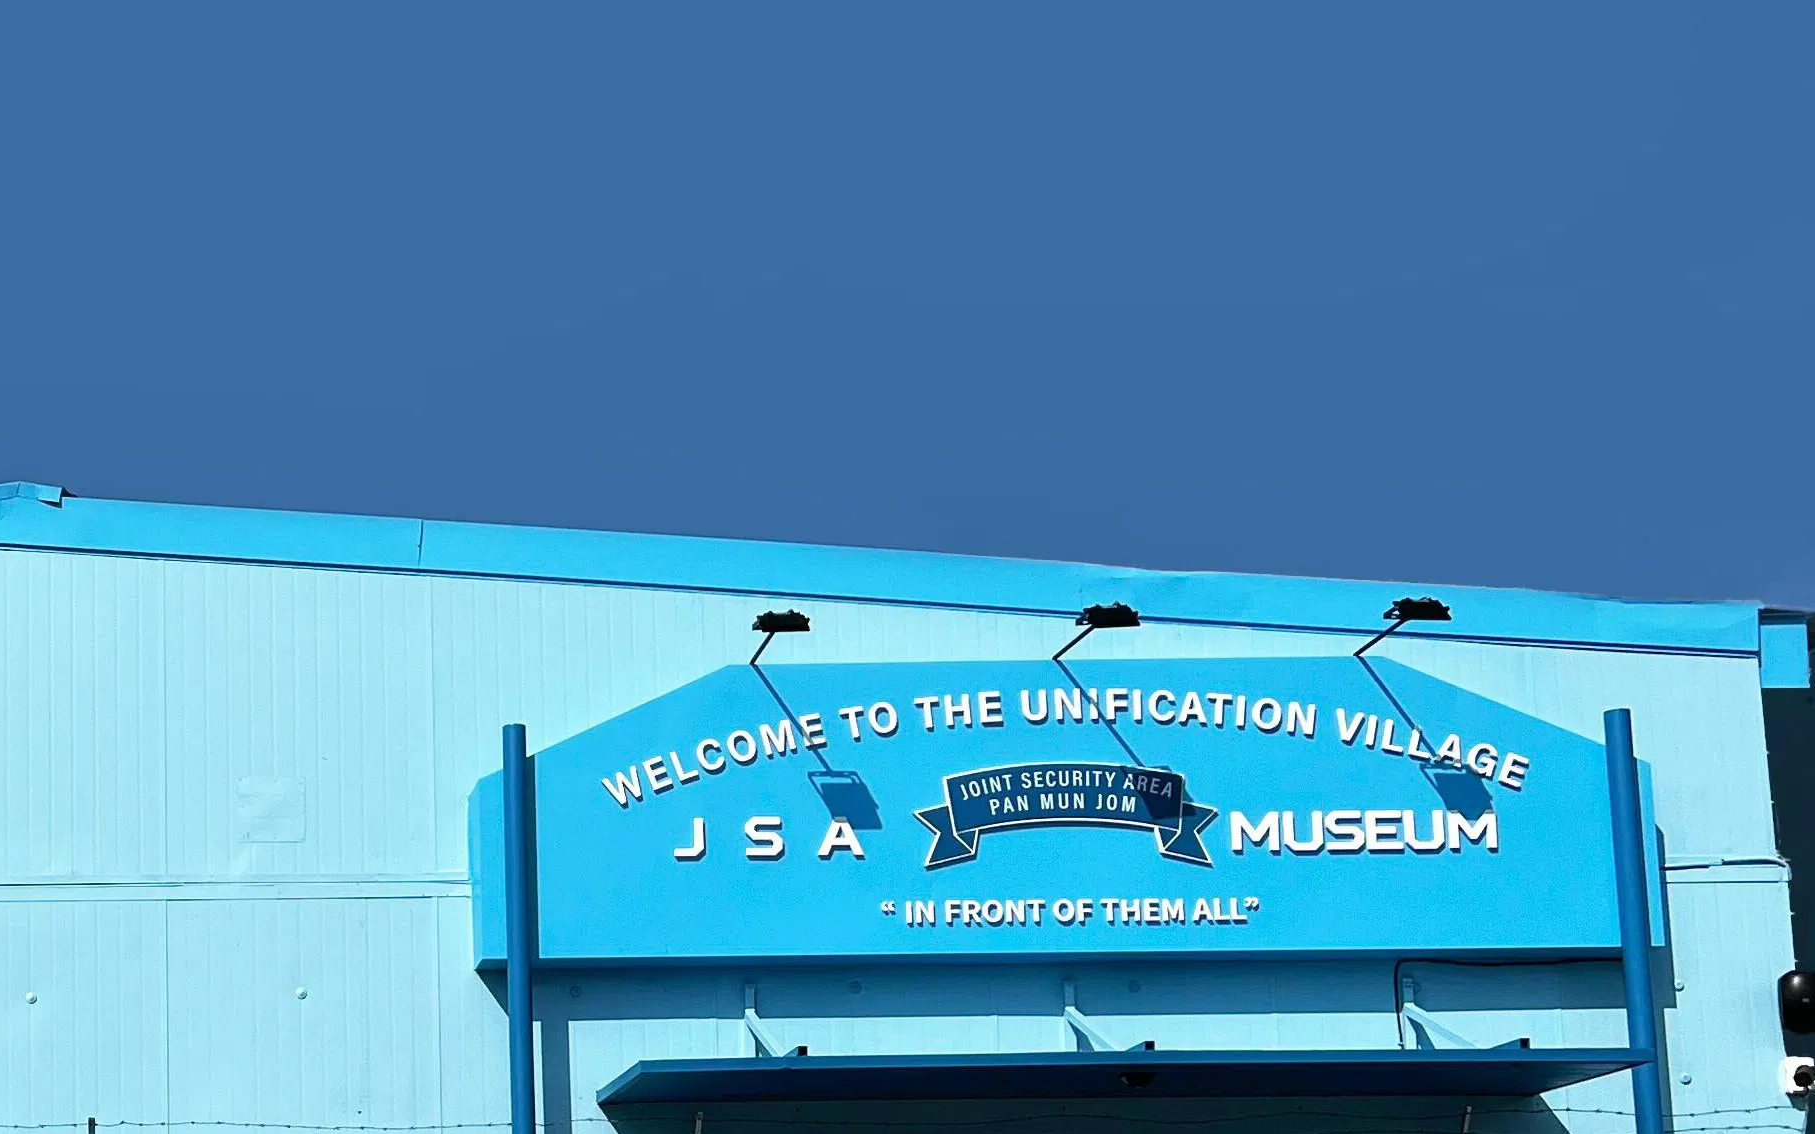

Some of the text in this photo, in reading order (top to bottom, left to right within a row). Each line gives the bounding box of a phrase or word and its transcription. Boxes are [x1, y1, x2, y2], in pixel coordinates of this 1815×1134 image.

[601, 687, 1530, 808] WELCOME TO THE UNIFICATION VILLAGE
[960, 770, 1173, 800] JOINT SECURITY AREA
[989, 793, 1135, 815] PAN MUN JOM
[1231, 809, 1499, 854] MUSEUM
[944, 899, 1046, 927] FRONT
[1053, 899, 1093, 925] OF
[1101, 898, 1183, 925] THEM
